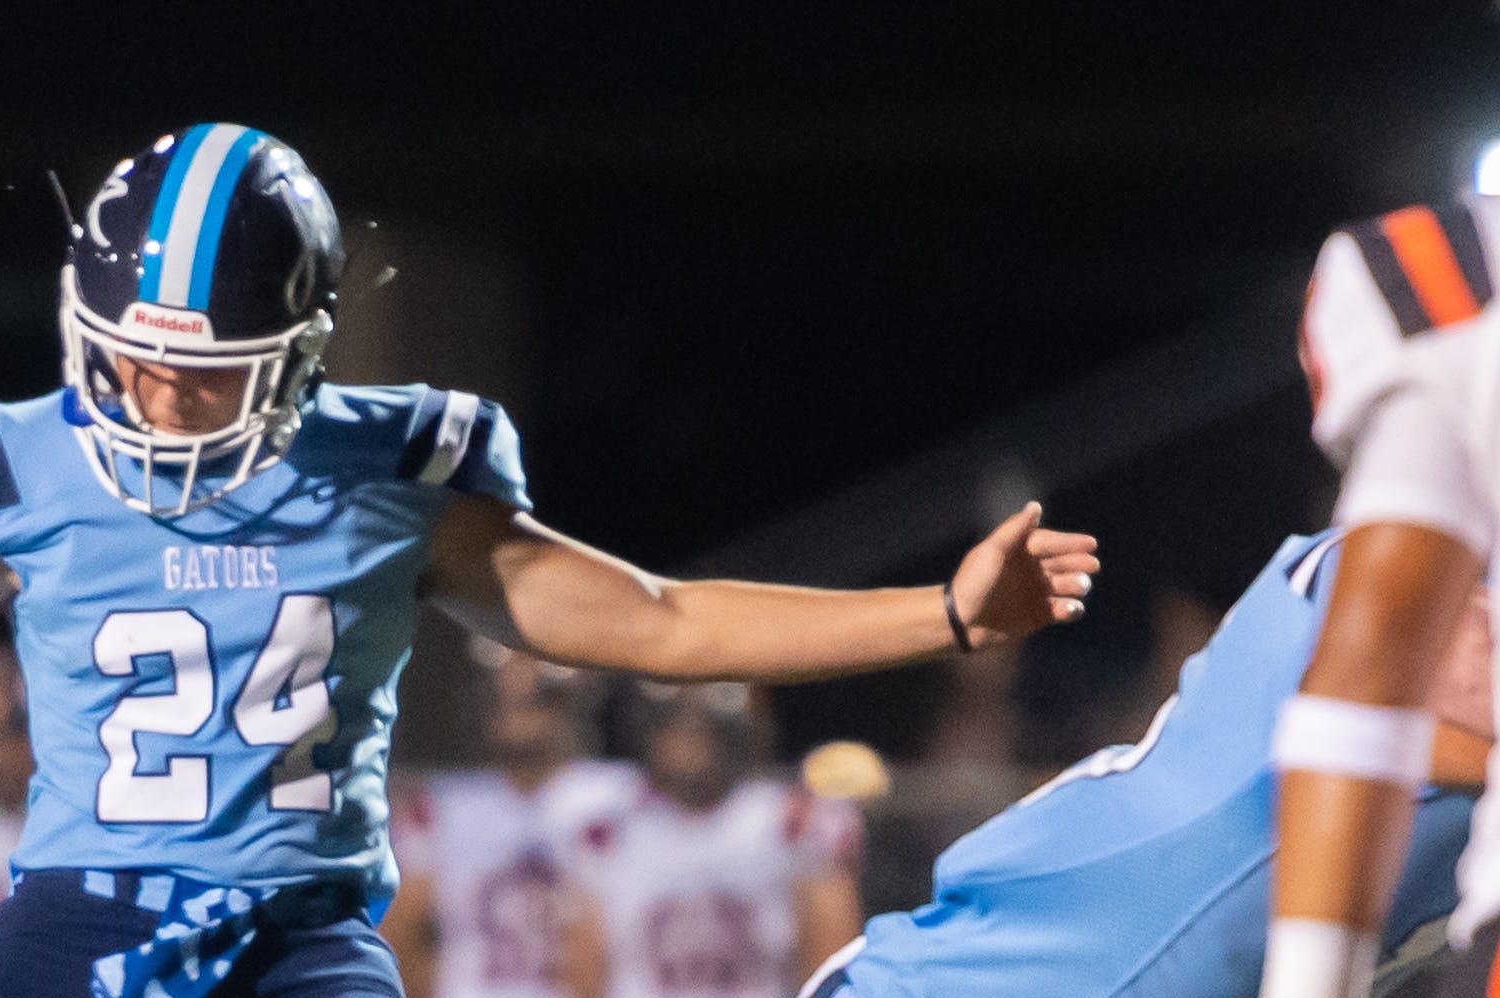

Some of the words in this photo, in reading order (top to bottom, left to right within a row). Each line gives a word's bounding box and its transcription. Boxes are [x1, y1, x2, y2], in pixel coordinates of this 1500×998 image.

[134, 310, 204, 334] Riddell
[162, 545, 278, 591] GATORS
[92, 591, 336, 825] 24
